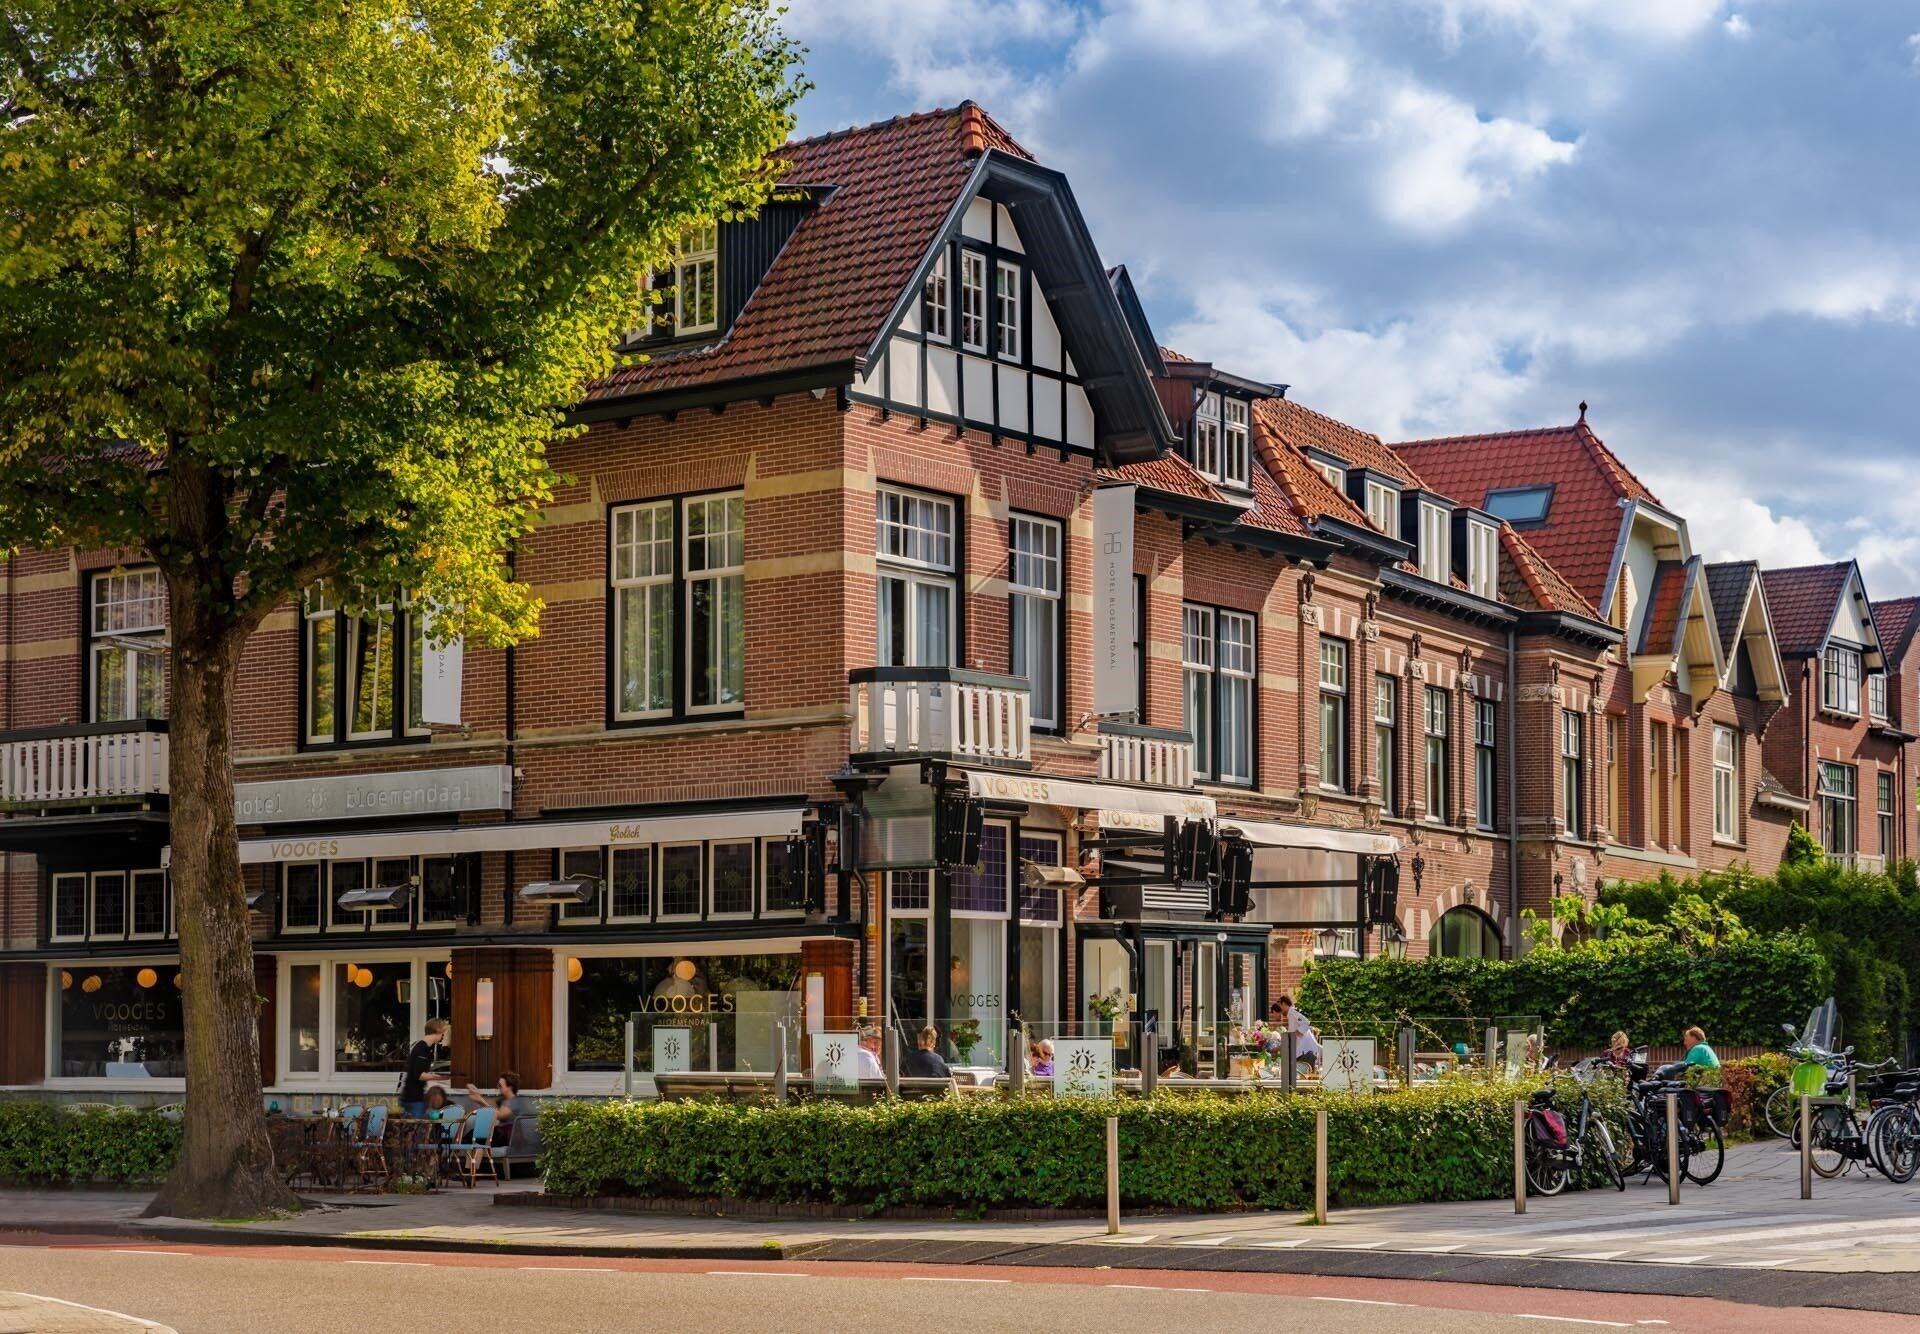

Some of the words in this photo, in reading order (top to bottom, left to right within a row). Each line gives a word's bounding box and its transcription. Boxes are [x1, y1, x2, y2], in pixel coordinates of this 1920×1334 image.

[1109, 597, 1118, 671] BLOEMENDAAL
[346, 780, 473, 810] bloemendaal
[985, 777, 1049, 800] VOOGES
[610, 825, 640, 841] Grolsch
[271, 840, 338, 858] VOOGES
[638, 993, 734, 1013] VOOGES
[948, 994, 1000, 1008] VOOGES
[92, 1003, 167, 1020] VOOGES
[657, 1018, 711, 1026] LOEMENDAA
